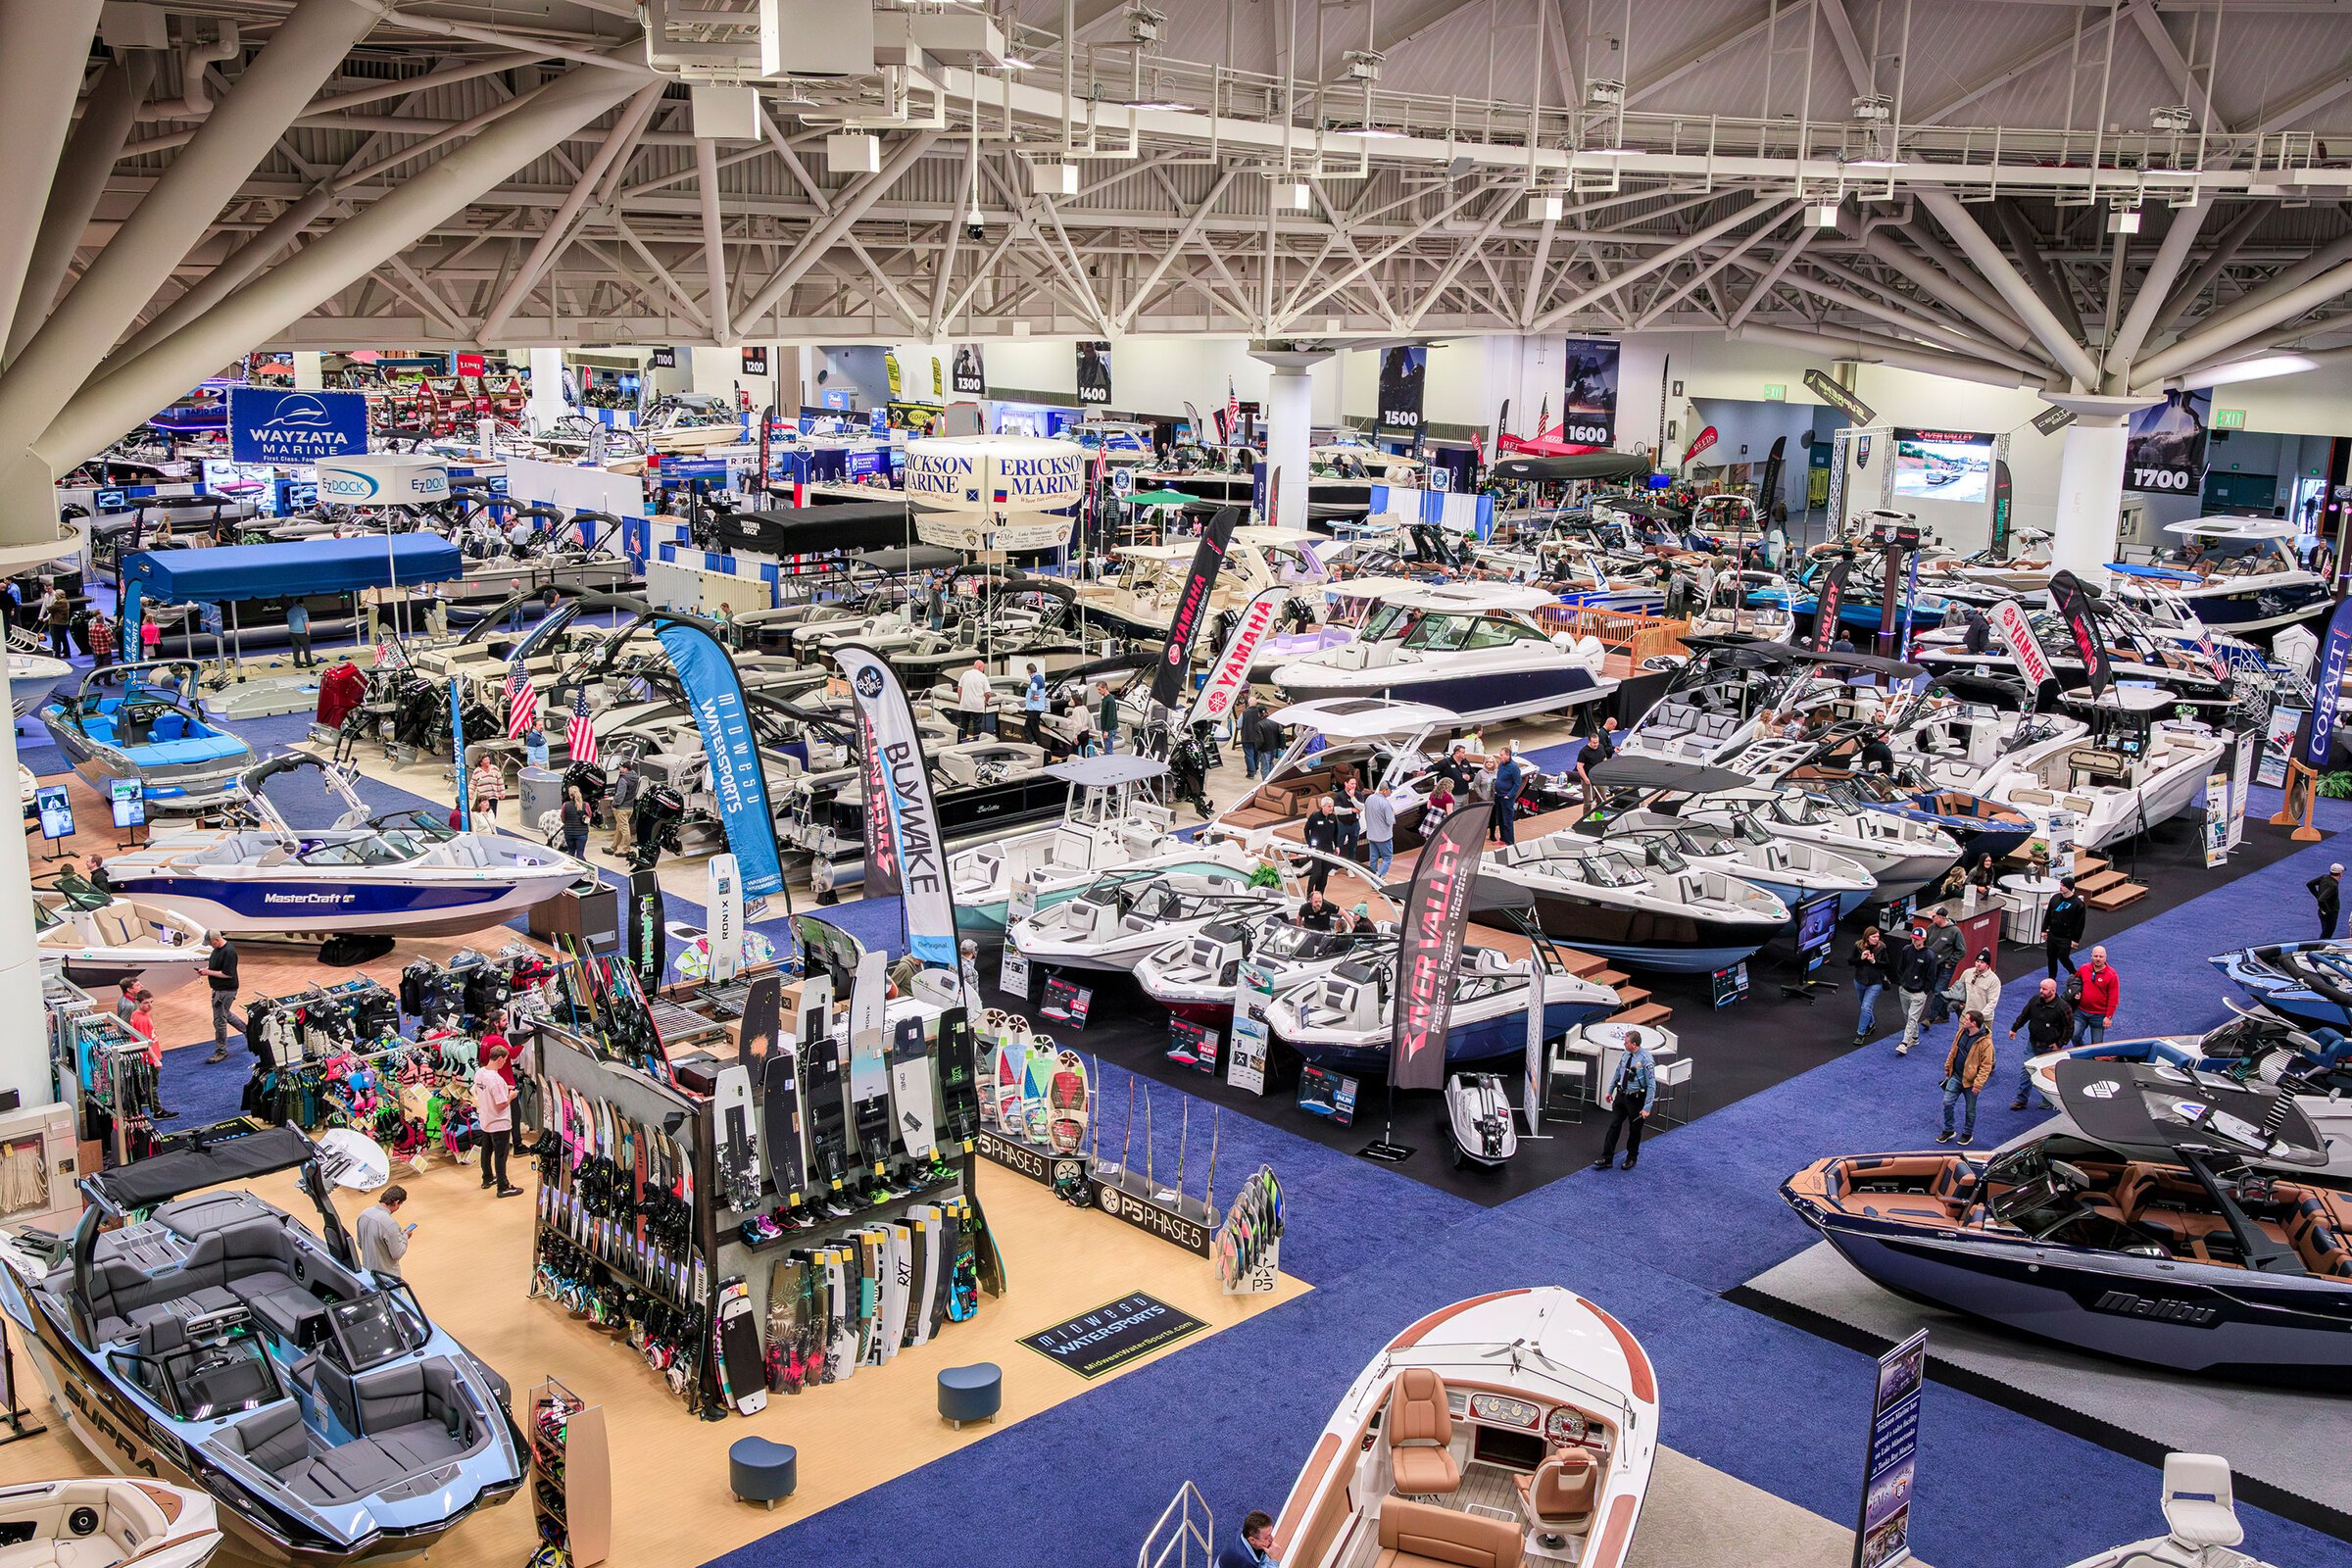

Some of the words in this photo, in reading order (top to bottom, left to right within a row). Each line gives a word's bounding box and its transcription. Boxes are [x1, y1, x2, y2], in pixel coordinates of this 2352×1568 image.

[656, 353, 673, 366] 1100
[745, 361, 764, 372] 1200
[956, 377, 981, 391] 1300
[1079, 387, 1106, 401] 1400
[1765, 384, 1784, 400] EXIT
[1385, 410, 1418, 426] 1500
[2217, 410, 2244, 426] EXIT
[249, 428, 349, 445] WAYZATA
[1569, 425, 1607, 443] 1600
[1693, 432, 1716, 453] REEDS
[1943, 432, 1975, 441] VALLEY
[263, 444, 338, 456] MARINE
[905, 454, 973, 474] RICKSON
[1010, 472, 1080, 496] MARINE
[2133, 468, 2189, 490] 1700
[742, 527, 759, 537] DOCK
[1995, 498, 2006, 542] SUPREME
[1173, 573, 1206, 644] YAMAHA
[1819, 580, 1839, 643] VALLEY
[1216, 601, 1273, 688] YAMAHA
[2010, 619, 2046, 687] YAMAHA
[857, 672, 872, 690] BUY
[862, 679, 883, 697] WAKE
[2312, 639, 2345, 757] COBALT
[700, 697, 743, 814] WATERSPORTS
[658, 793, 681, 808] MERCURY
[884, 741, 941, 896] BUYWAKE
[264, 893, 341, 904] MasterCraft
[1418, 831, 1461, 949] VALLEY
[1449, 867, 1468, 920] Marine
[1441, 929, 1456, 971] Sport
[1438, 972, 1447, 985] &
[1431, 988, 1446, 1034] Power
[992, 1137, 1043, 1177] PHASE5
[1144, 1206, 1201, 1249] PHASE5
[897, 1256, 911, 1287] RXT
[1251, 1279, 1273, 1292] P5
[2093, 1291, 2217, 1323] Malibu
[1051, 1304, 1166, 1356] WATERSPORTS
[1083, 1321, 1194, 1372] MidwestWaterSports.com
[64, 1379, 159, 1478] SUPRA
[1874, 1432, 1888, 1449] opened
[1892, 1422, 1903, 1436] sales
[1902, 1413, 1918, 1429] facility
[1876, 1415, 1895, 1433] Erickson
[1894, 1407, 1910, 1422] Marine
[1881, 1444, 1891, 1456] Lake
[1891, 1428, 1916, 1450] Minnetonka
[1878, 1457, 1890, 1472] Tonka
[1898, 1442, 1914, 1458] Marina
